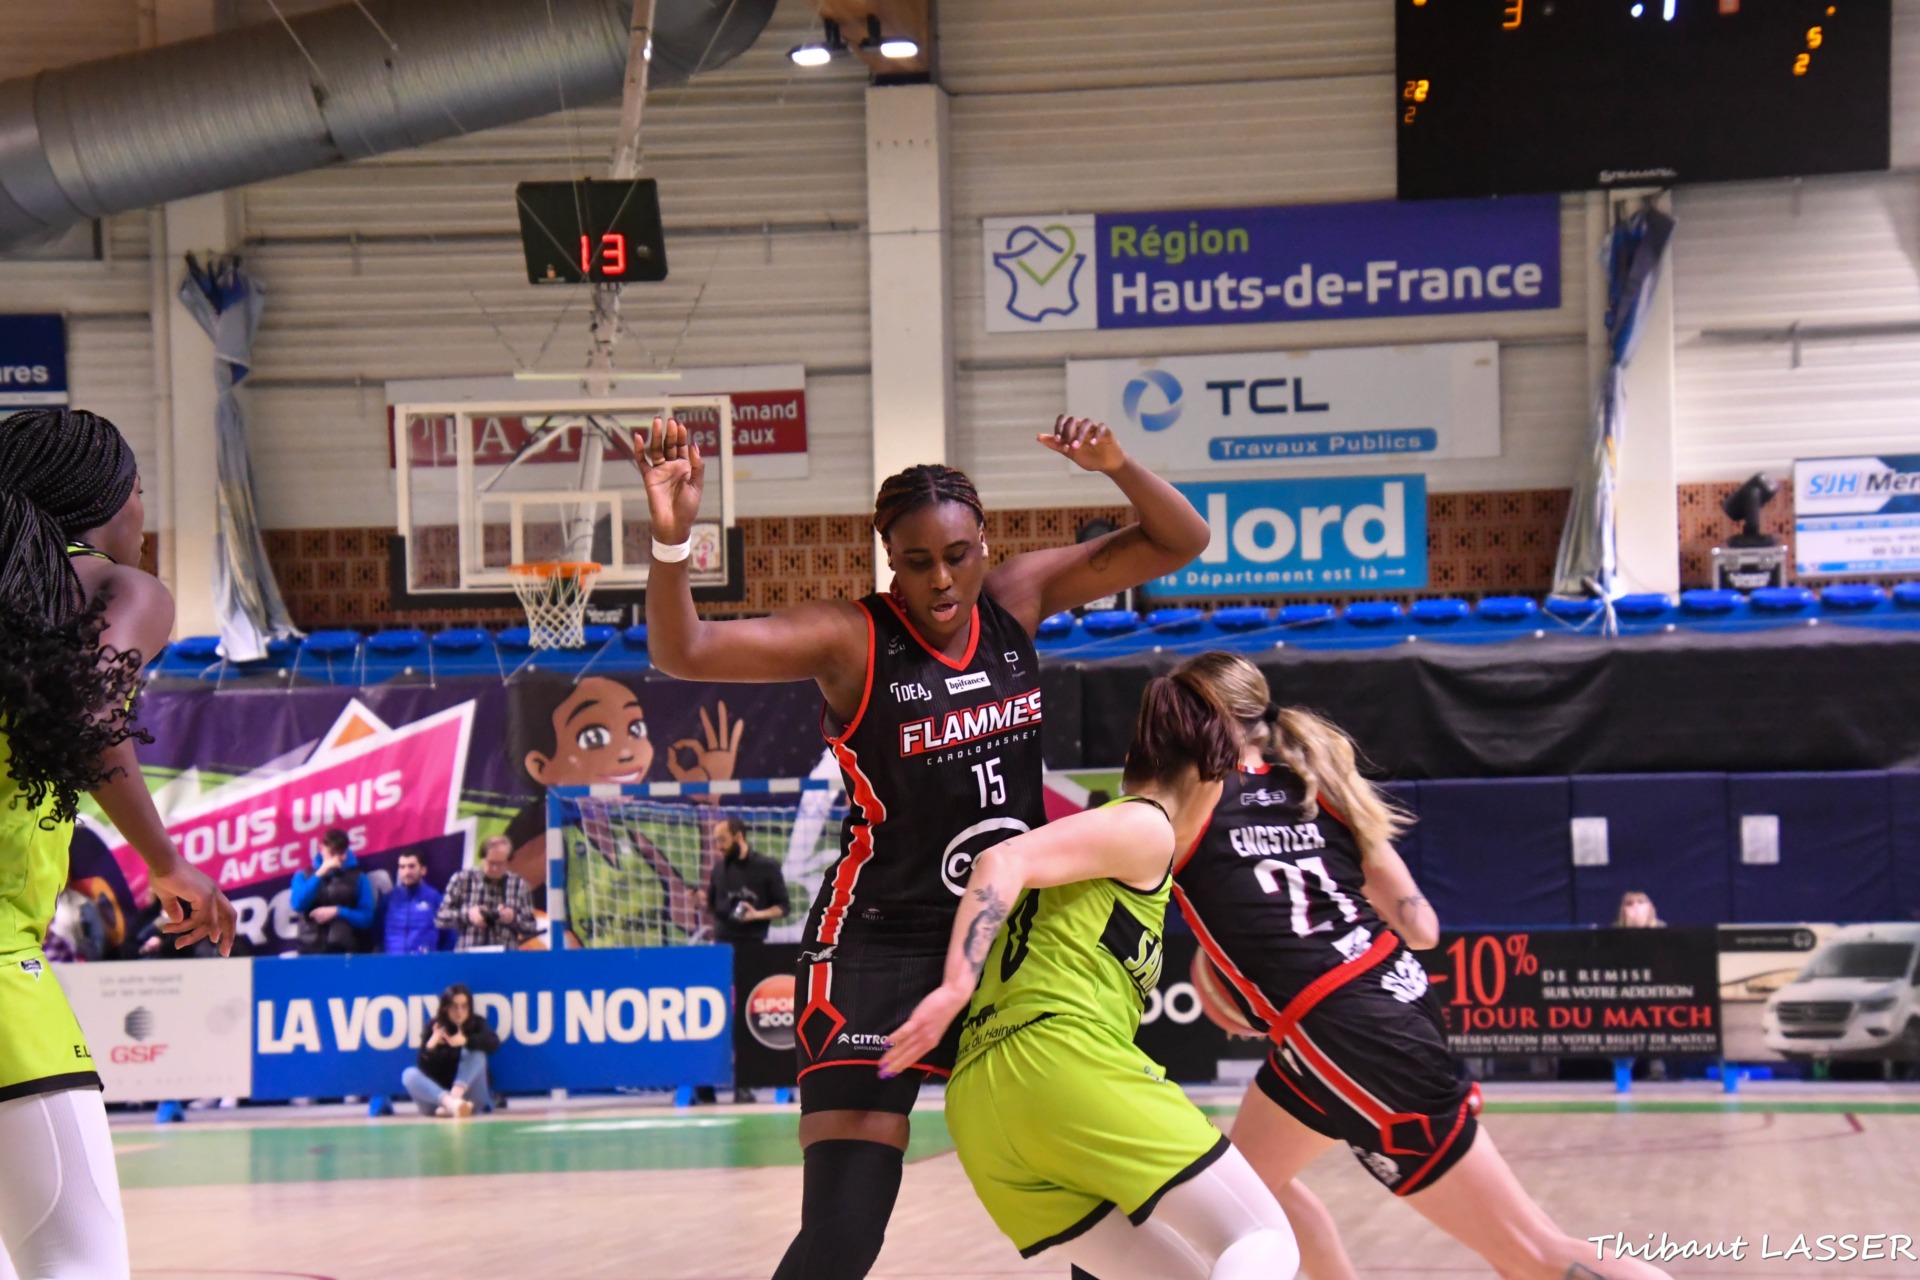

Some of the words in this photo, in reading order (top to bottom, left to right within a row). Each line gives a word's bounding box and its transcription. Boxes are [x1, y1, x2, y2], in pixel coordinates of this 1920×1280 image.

[580, 233, 627, 275] 13
[1110, 220, 1250, 265] Région
[1111, 260, 1543, 315] Hauts-de-France
[0, 364, 50, 383] res
[1205, 377, 1330, 416] TCL
[1219, 438, 1318, 457] Travaux
[1329, 433, 1422, 452] Publics
[1808, 473, 1857, 496] SJH
[1186, 566, 1314, 588] Département
[1322, 564, 1352, 582] est
[1360, 563, 1379, 580] là
[894, 682, 928, 702] IDEA
[949, 675, 986, 691] bpifrance
[902, 690, 1042, 754] FLAMMES
[926, 744, 983, 767] CAROLO
[986, 729, 1038, 750] BASKET
[970, 756, 1007, 809] 15
[291, 769, 403, 834] UNIS
[1229, 823, 1326, 857] ENGSTLER
[257, 1000, 321, 1054] LA
[565, 986, 726, 1044] NORD
[1461, 1006, 1539, 1035] JOUR
[1548, 1005, 1592, 1029] DU
[1602, 1004, 1713, 1028] MATCH
[110, 1044, 168, 1064] GSF
